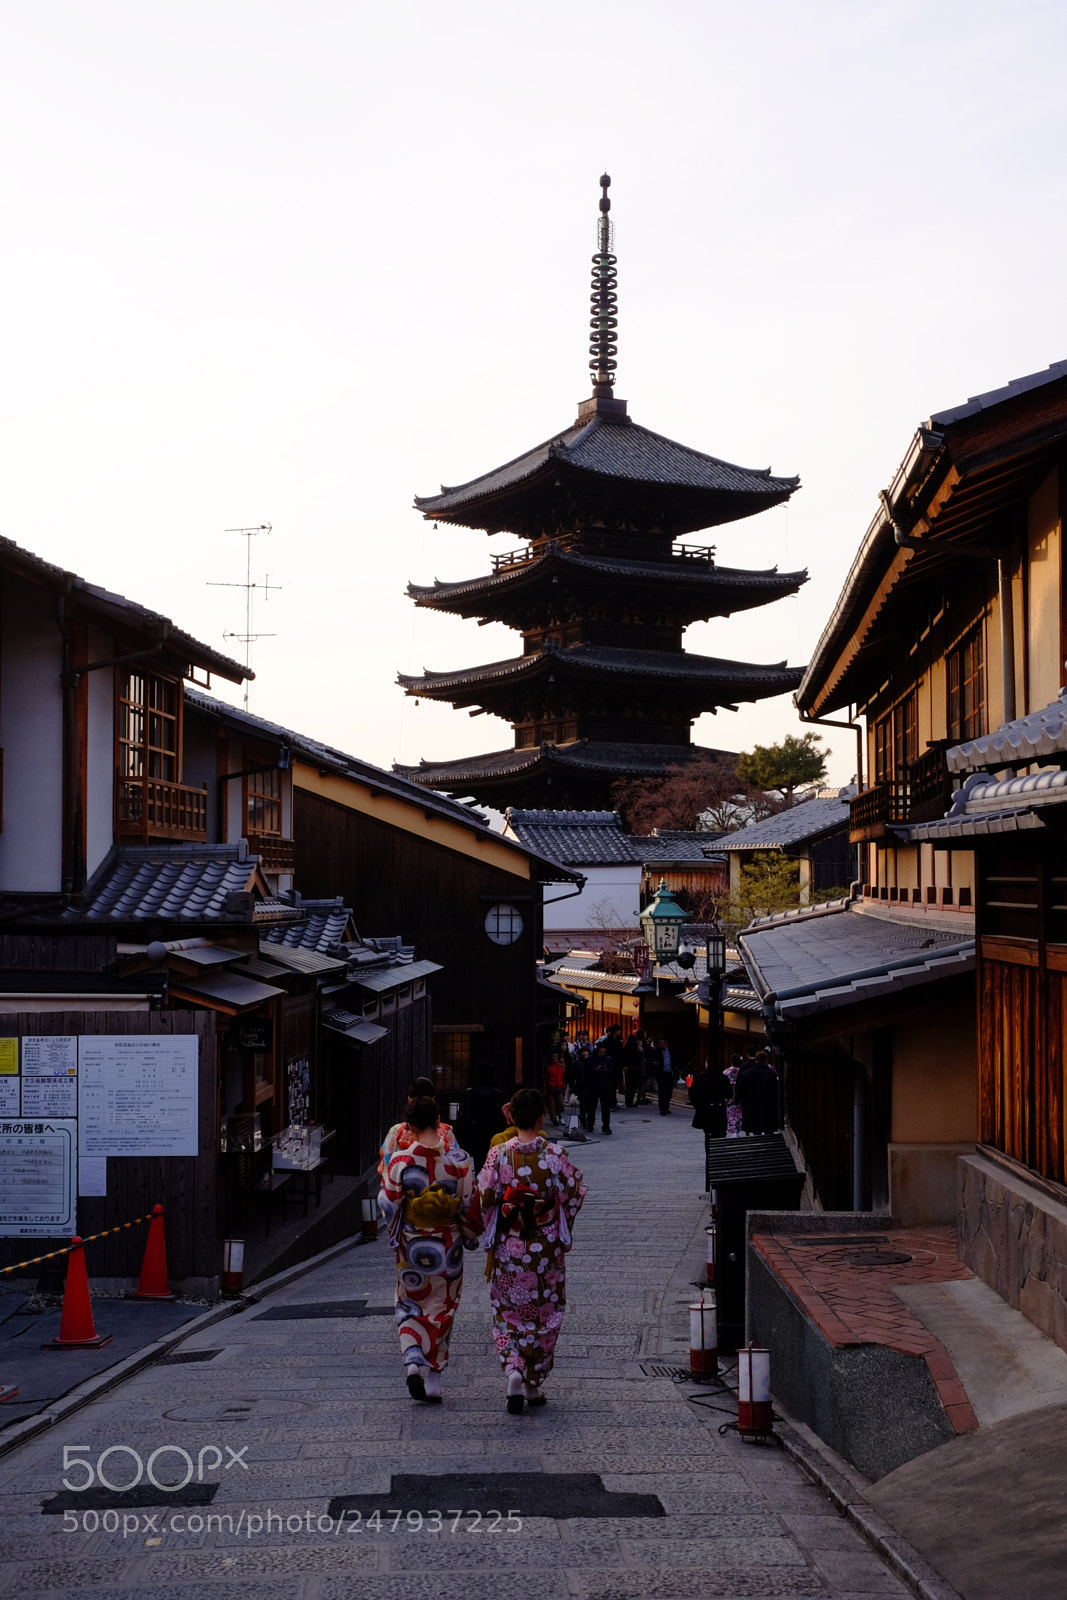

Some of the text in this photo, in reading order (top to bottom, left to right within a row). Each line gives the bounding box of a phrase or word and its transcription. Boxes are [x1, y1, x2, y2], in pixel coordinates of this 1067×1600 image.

[0, 1123, 55, 1134] 所の皆様へ
